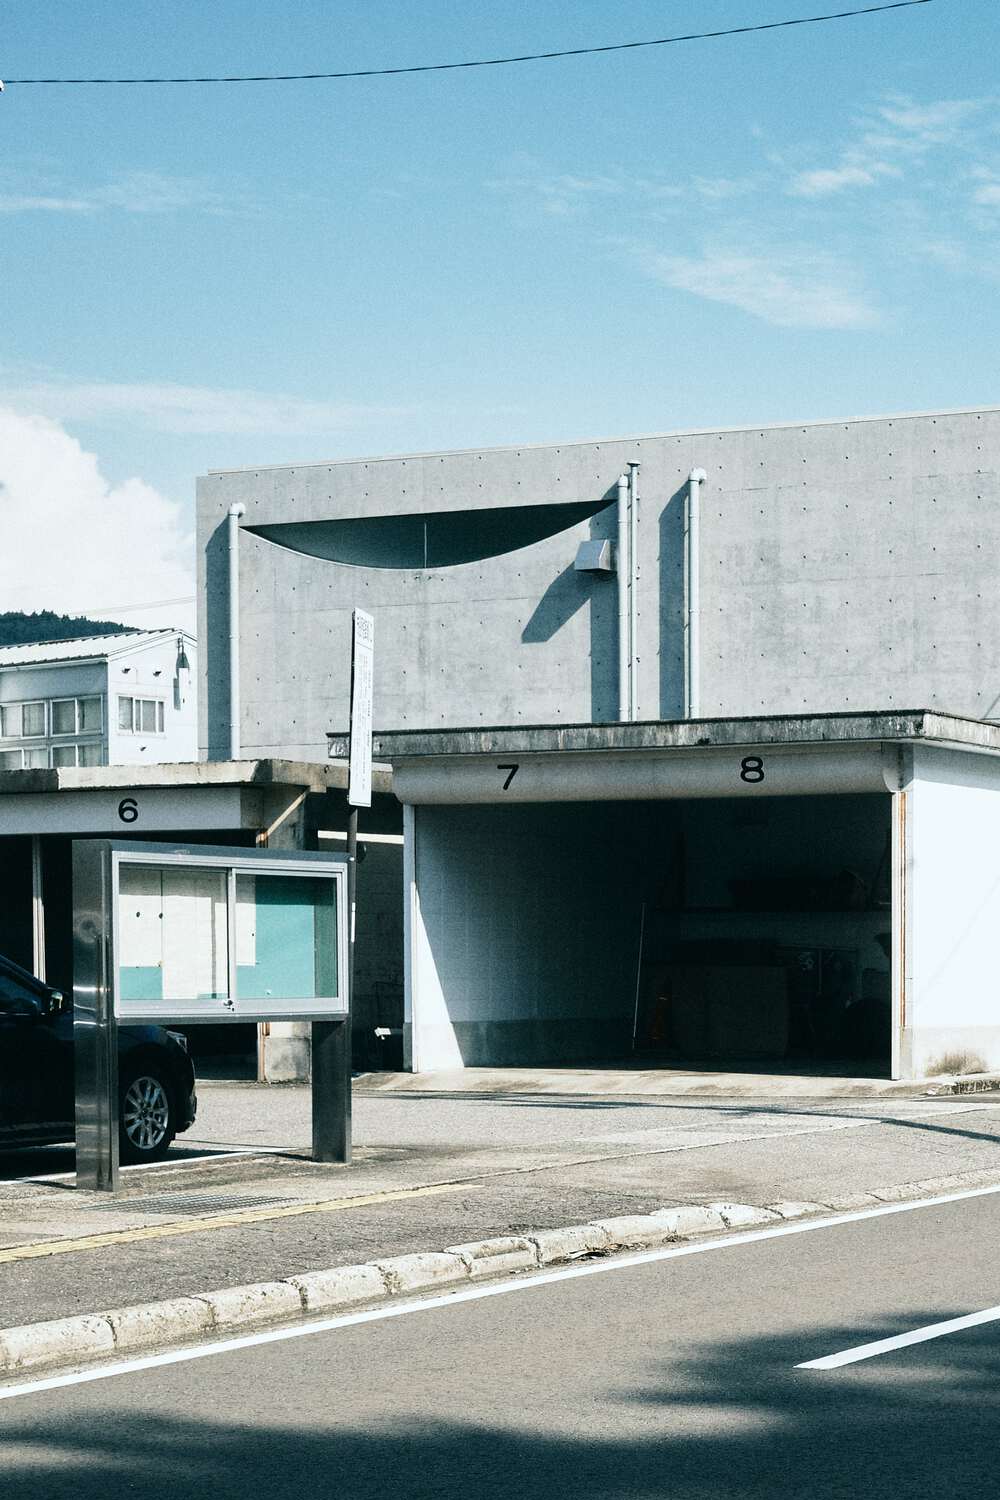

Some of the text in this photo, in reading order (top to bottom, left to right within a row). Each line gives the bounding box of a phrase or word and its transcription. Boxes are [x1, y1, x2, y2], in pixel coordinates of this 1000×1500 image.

[496, 764, 519, 790] 7
[740, 756, 765, 784] 8
[118, 798, 139, 823] 6
